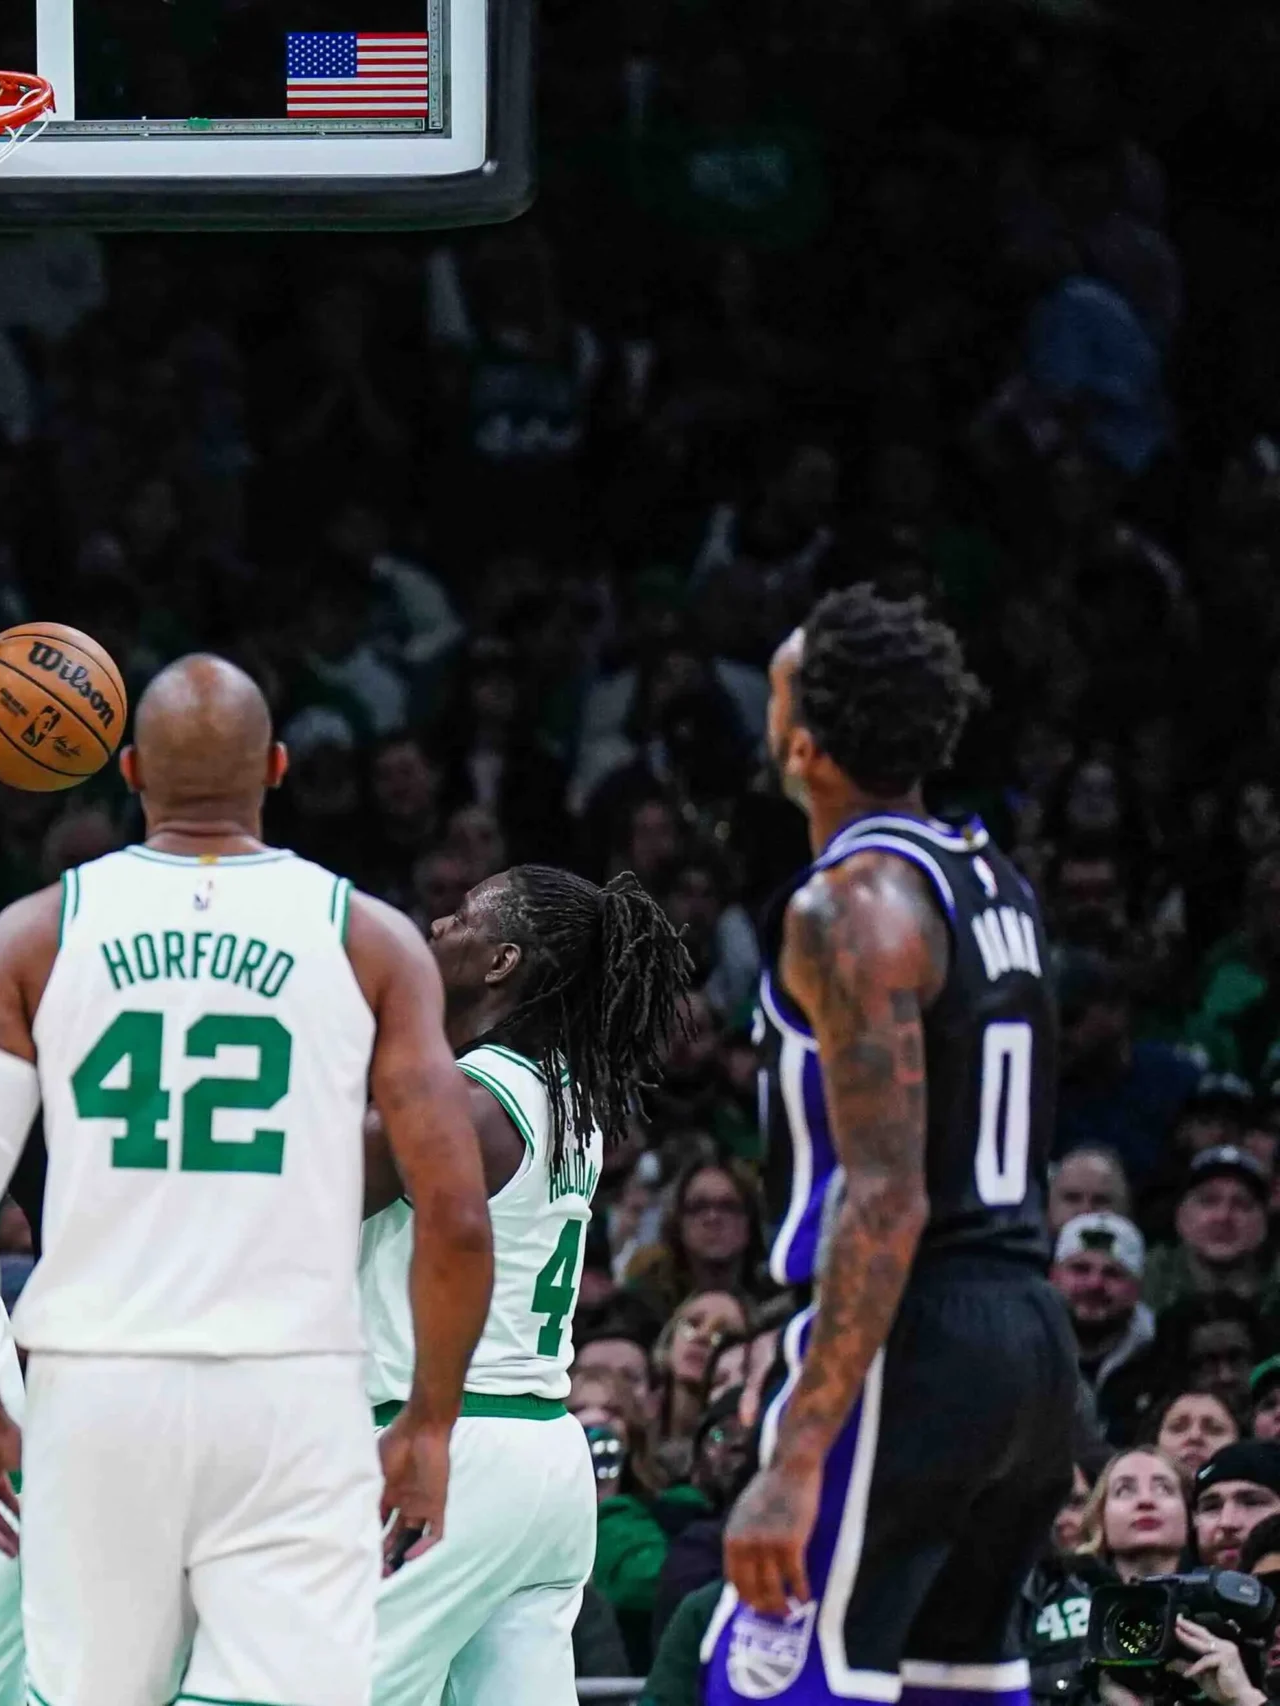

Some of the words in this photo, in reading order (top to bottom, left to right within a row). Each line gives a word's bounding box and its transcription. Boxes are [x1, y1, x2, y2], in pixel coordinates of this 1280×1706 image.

[27, 641, 115, 729] Wilson
[101, 930, 295, 999] HORFORD
[71, 1010, 293, 1175] 42
[975, 1021, 1033, 1207] 0
[548, 1147, 599, 1205] HOLIDA
[531, 1218, 583, 1358] 4
[1035, 1596, 1093, 1642] 42
